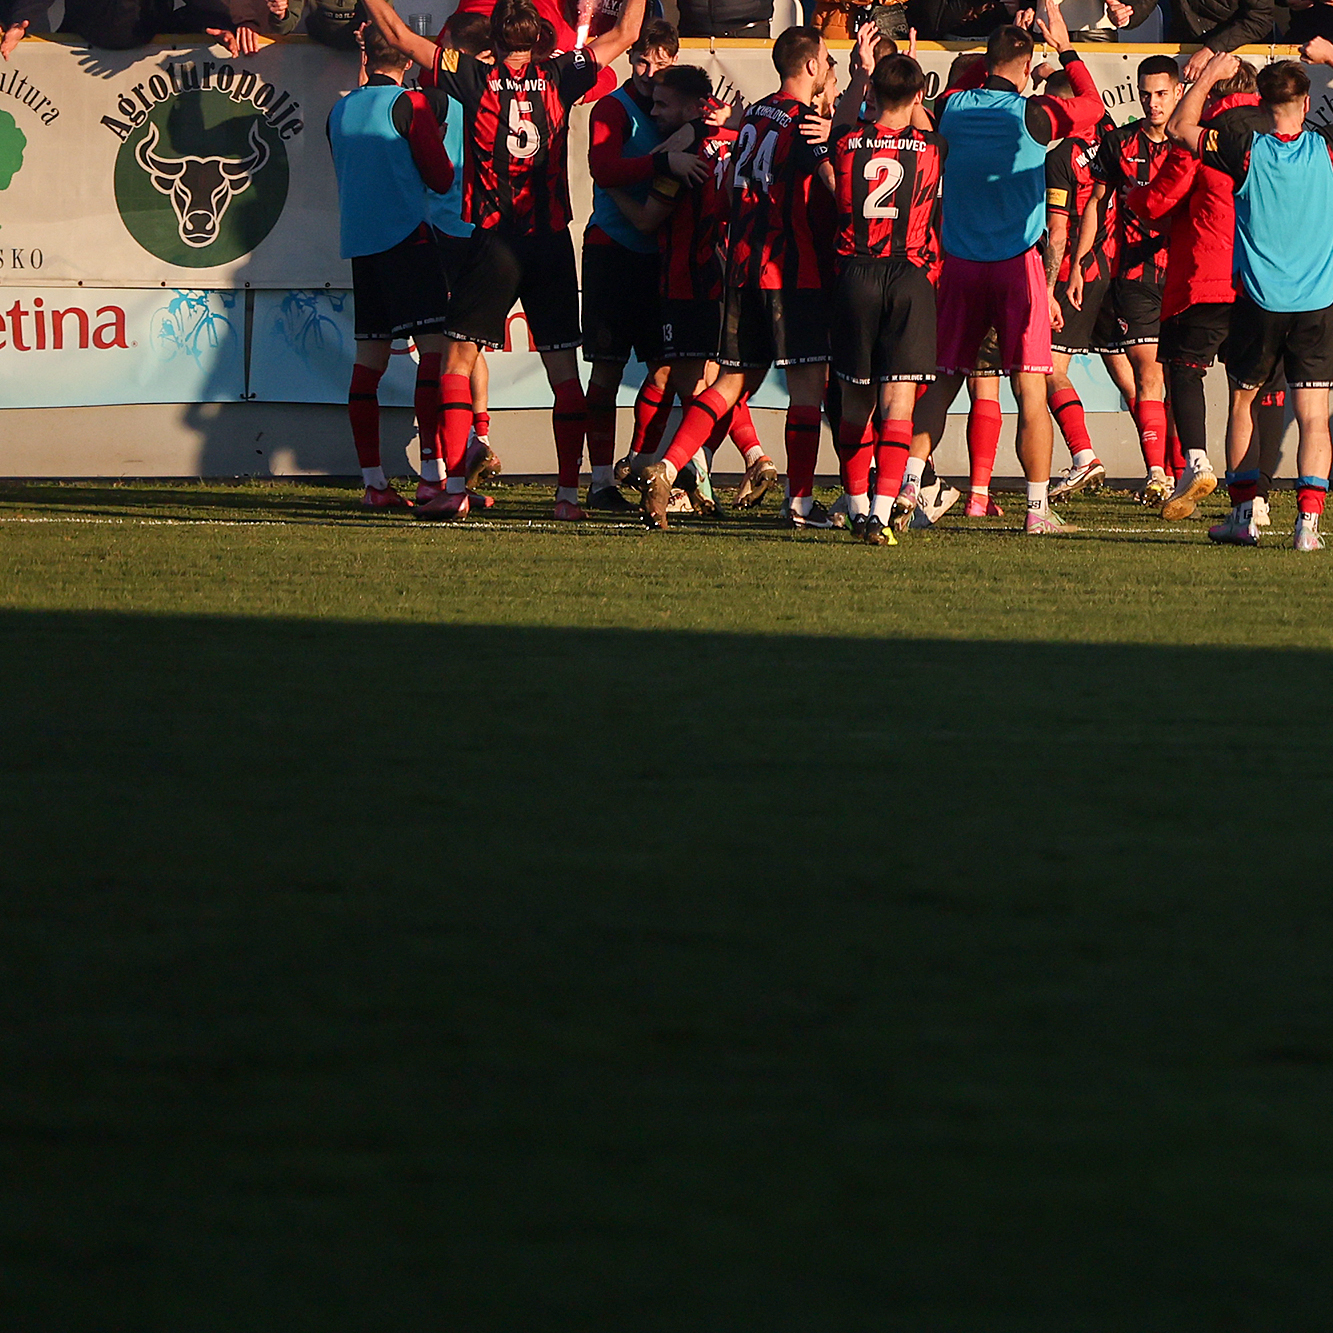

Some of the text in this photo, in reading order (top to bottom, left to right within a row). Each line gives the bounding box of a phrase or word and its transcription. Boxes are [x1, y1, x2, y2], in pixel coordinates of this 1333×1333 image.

[100, 60, 304, 143] Agroturopolje
[506, 99, 541, 158] 5
[733, 123, 780, 195] 24
[848, 137, 927, 153] NK KURILOVEC
[1075, 151, 1090, 168] NK
[862, 156, 905, 220] 2
[0, 297, 129, 352] tina
